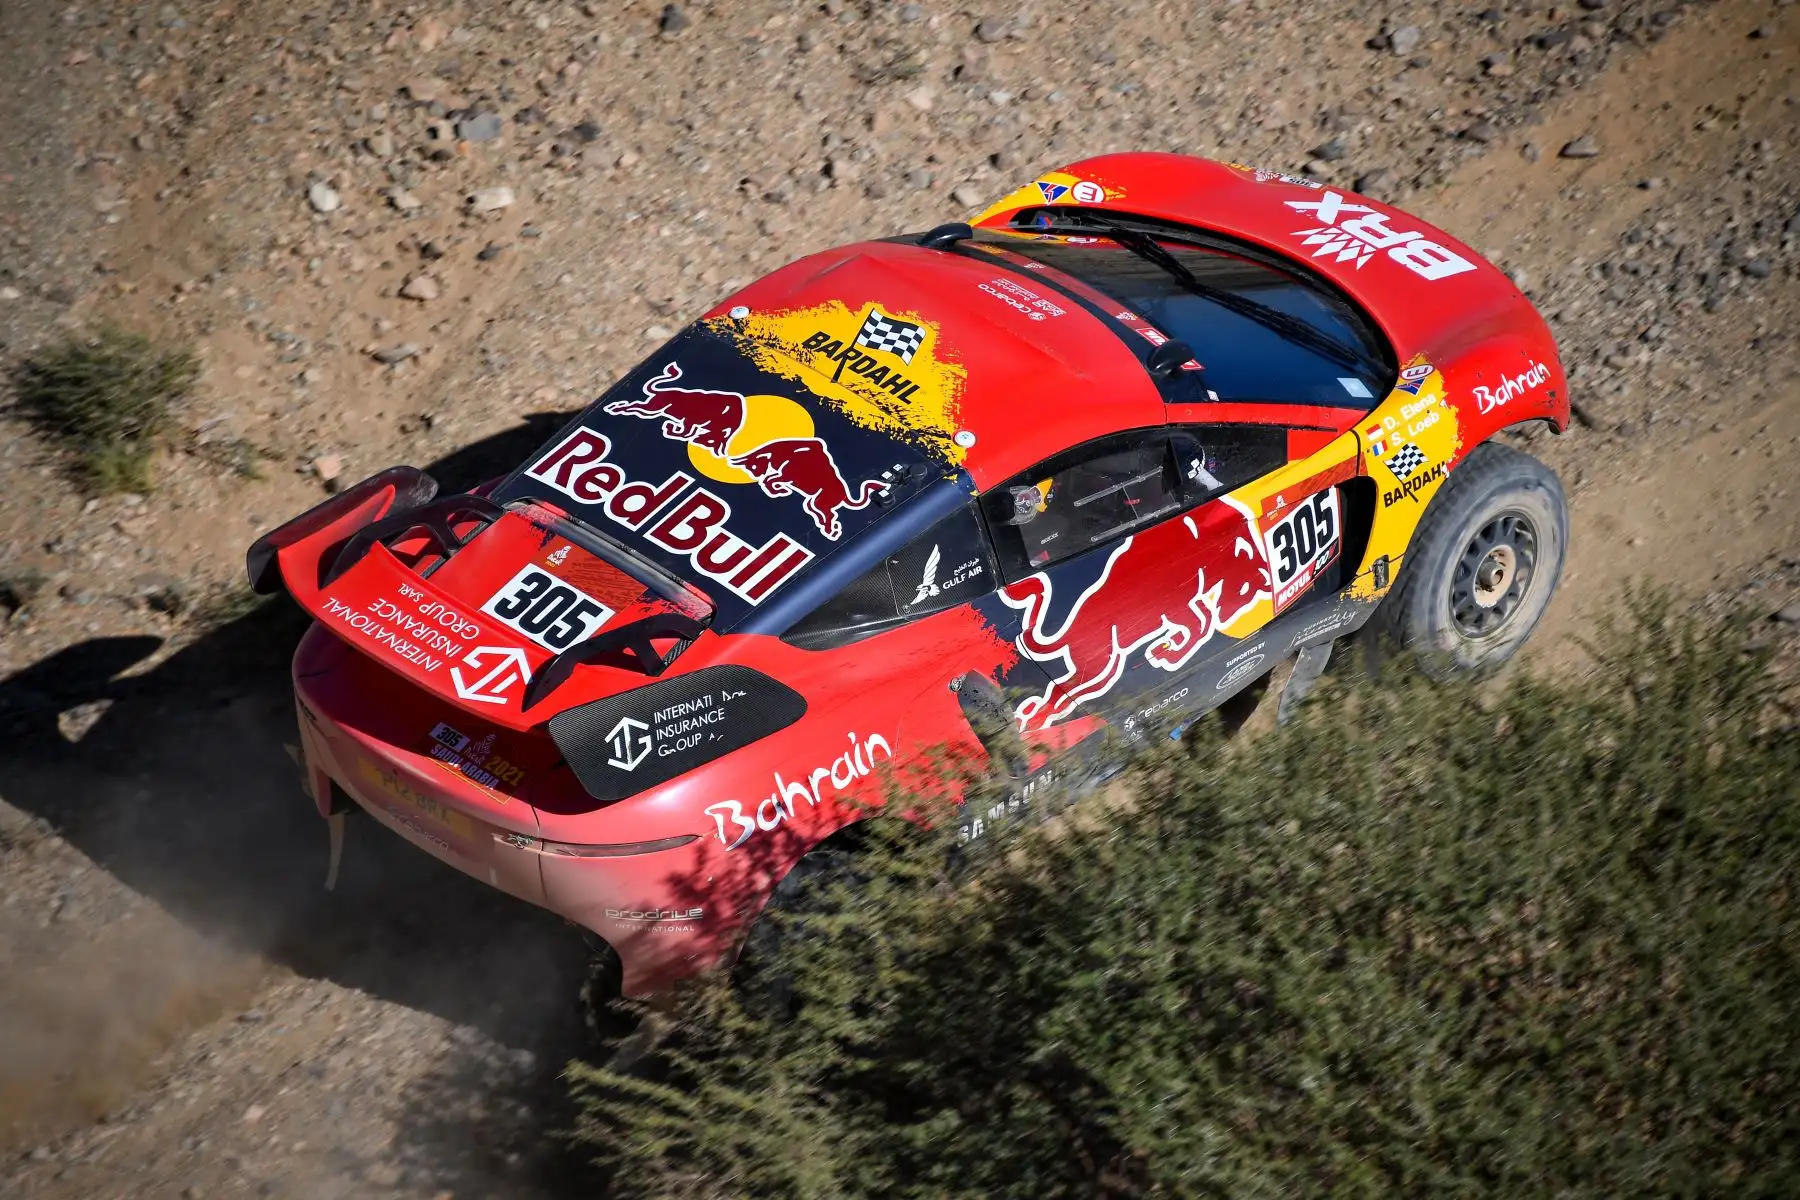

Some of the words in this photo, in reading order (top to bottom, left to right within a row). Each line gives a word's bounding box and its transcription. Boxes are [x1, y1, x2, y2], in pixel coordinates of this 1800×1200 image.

[1283, 190, 1477, 281] BRX
[802, 331, 920, 405] BARDAHL
[1472, 359, 1552, 415] Bahrain
[1391, 431, 1406, 447] S.
[1407, 410, 1440, 438] Loeb
[1399, 392, 1437, 420] Elena
[1272, 487, 1334, 583] 305
[398, 583, 424, 602] SARL
[942, 572, 967, 590] GULF
[967, 565, 983, 580] AIR
[1277, 571, 1311, 609] MOTUL
[367, 597, 463, 658] INSURANCE
[418, 601, 481, 641] GROUP
[494, 571, 605, 650] 305
[322, 597, 444, 673] INTERNATIONAL
[436, 726, 462, 747] 305
[655, 707, 726, 741] INSURANCE
[430, 743, 460, 768] SAUDI
[460, 762, 500, 791] ARABIA
[484, 755, 526, 787] 2021
[704, 731, 892, 852] Bahrain
[957, 769, 1060, 848] SAMSUN
